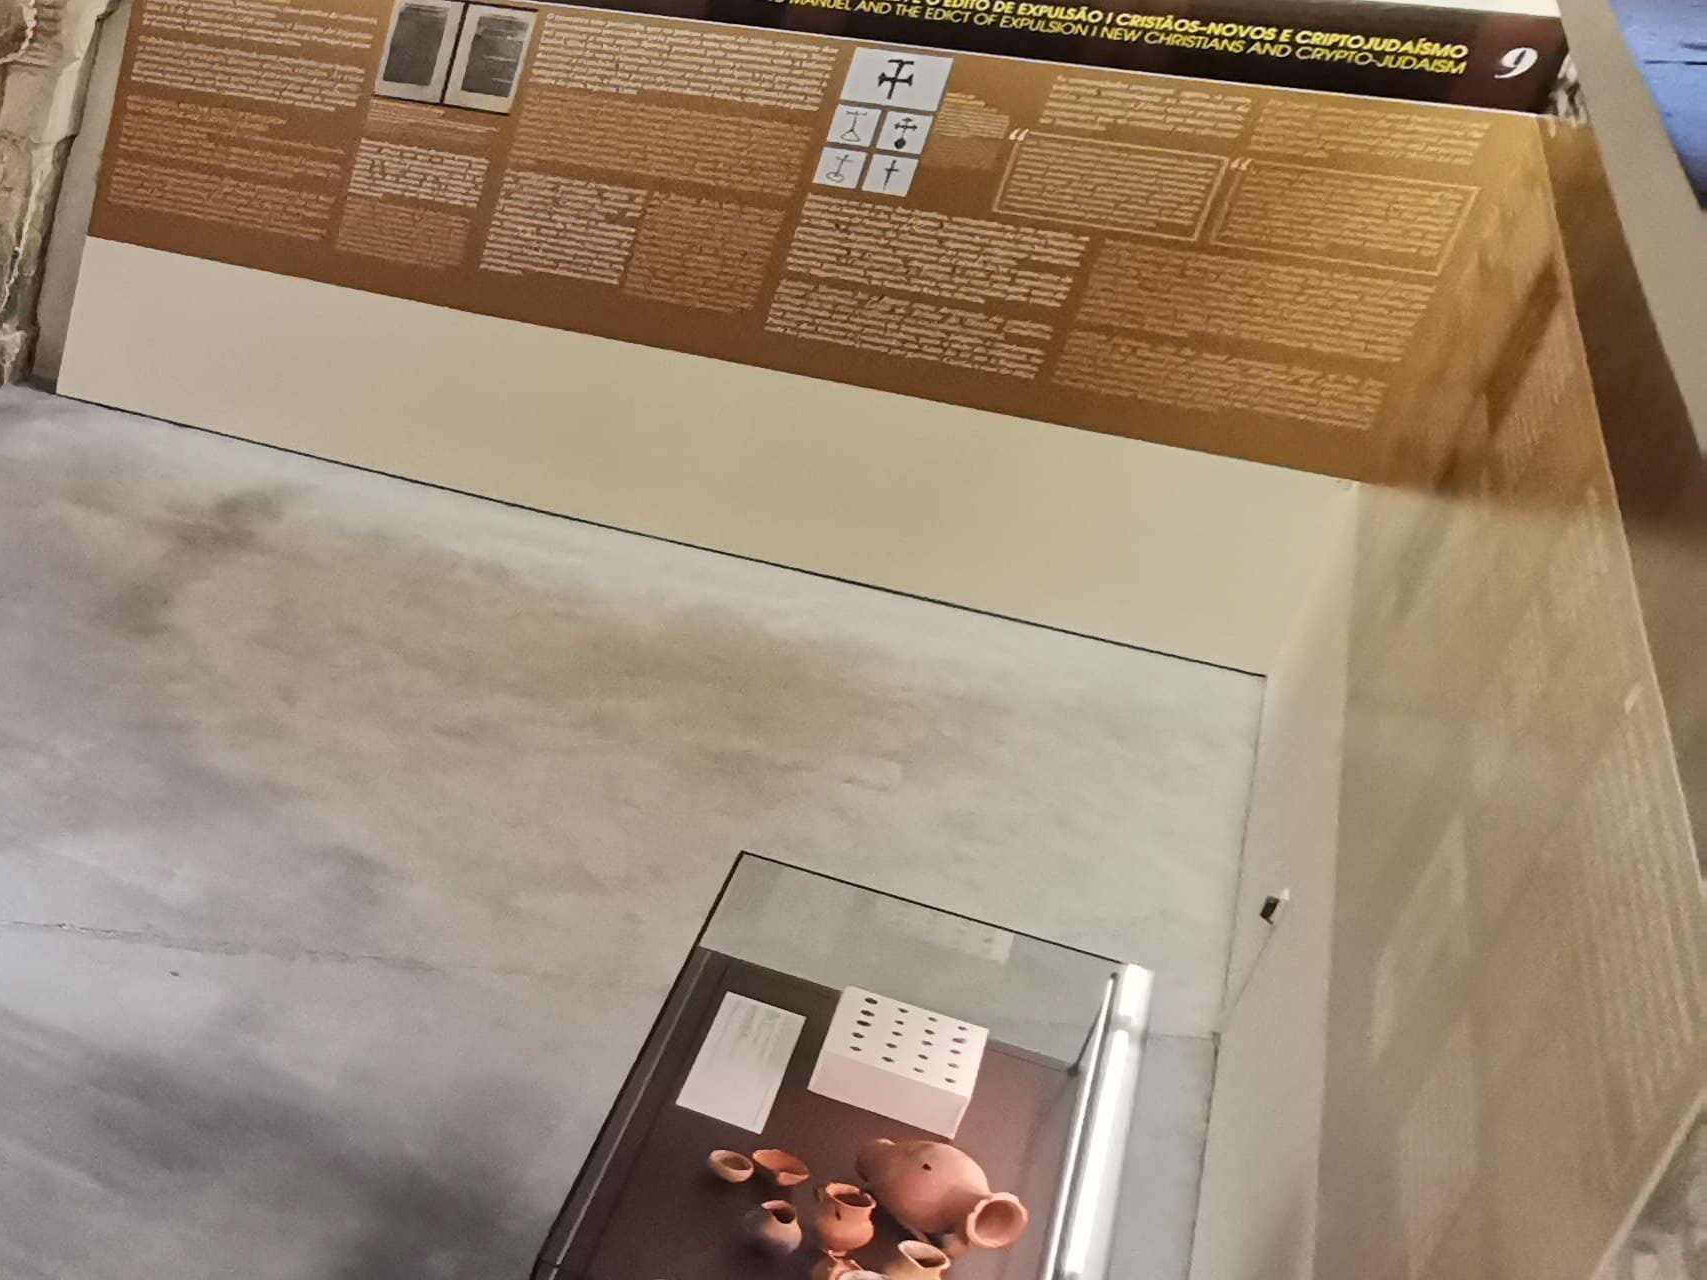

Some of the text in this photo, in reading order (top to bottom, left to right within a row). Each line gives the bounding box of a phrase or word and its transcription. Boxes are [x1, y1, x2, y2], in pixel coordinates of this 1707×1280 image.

[854, 0, 891, 15] AND
[895, 3, 921, 18] THE
[924, 6, 971, 23] EDICT
[973, 12, 998, 26] OF
[999, 15, 1089, 36] EXPULSION
[1099, 26, 1142, 42] NEW
[1144, 31, 1246, 53] CHRISTIANS
[1246, 41, 1292, 58] AND
[1295, 46, 1467, 74] CRYPTO-JUDAISM
[993, 0, 1016, 14] DE
[1017, 3, 1103, 23] EXPULSÃO
[1116, 13, 1278, 40] CRISTÃOS-NOVOS
[1279, 29, 1293, 43] E
[1295, 30, 1468, 59] CRIPTOJUDAÍSMO
[1494, 47, 1538, 79] 9
